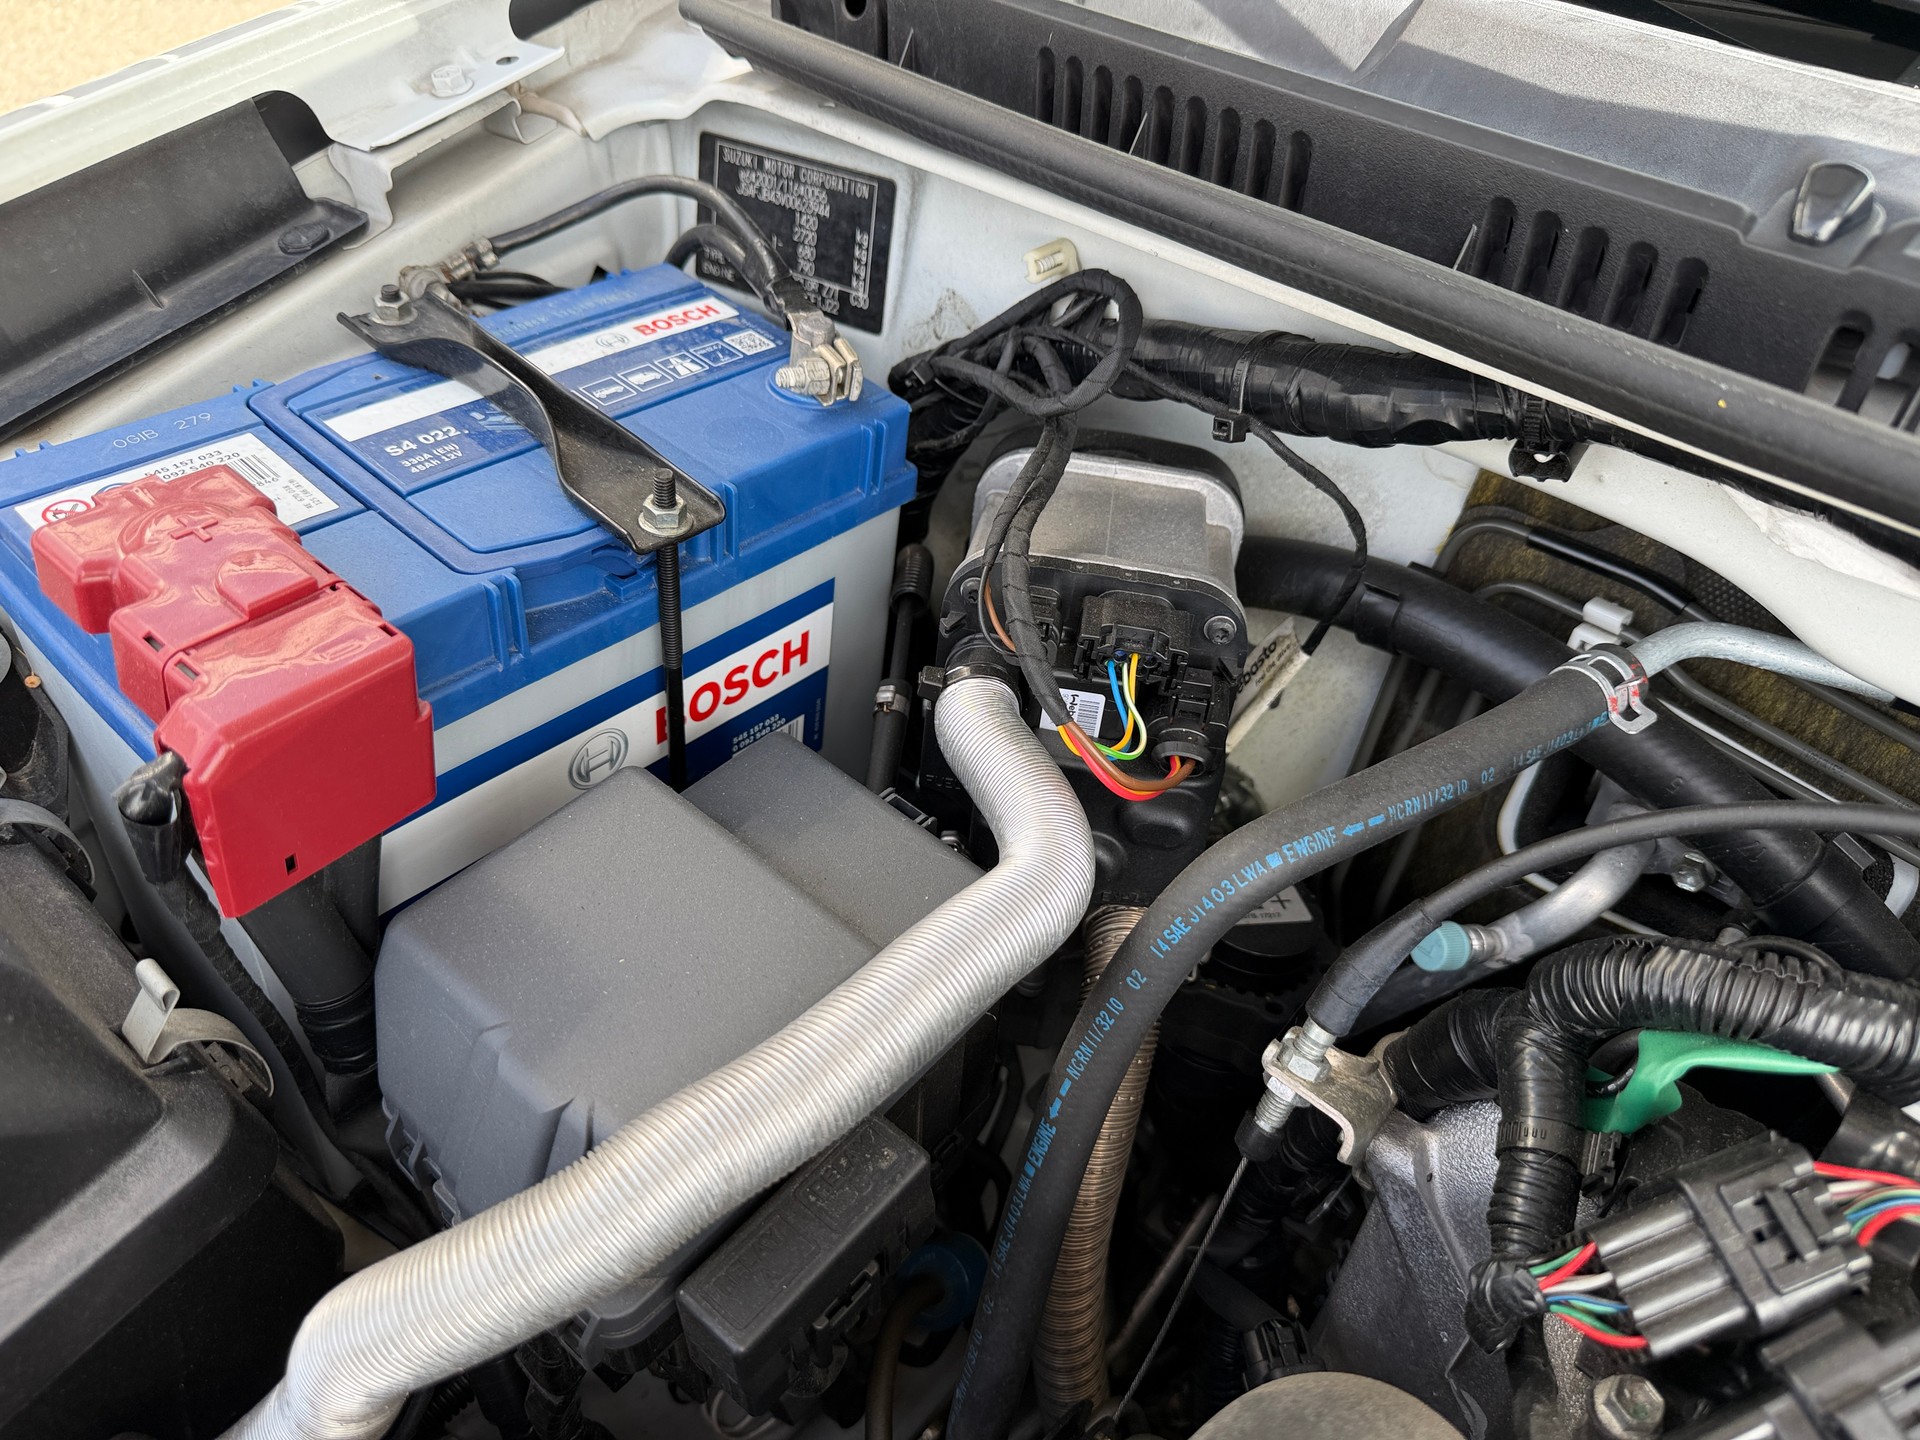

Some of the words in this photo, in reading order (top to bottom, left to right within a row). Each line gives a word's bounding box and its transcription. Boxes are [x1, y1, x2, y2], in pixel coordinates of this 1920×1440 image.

[722, 147, 758, 169] SUZUKI
[763, 157, 796, 179] MOTOR
[800, 167, 870, 200] CORPORATION
[702, 260, 736, 283] ENGINE
[632, 304, 721, 337] BOSCH
[174, 412, 211, 430] 279
[172, 458, 195, 470] 157
[197, 450, 222, 461] 033
[384, 439, 418, 458] S4
[401, 452, 434, 469] 330A
[433, 443, 460, 458] (EN)
[162, 468, 187, 481] 092
[216, 452, 241, 464] 220
[410, 459, 441, 475] 45Ah
[439, 451, 463, 464] 12V
[732, 744, 738, 752] 0
[739, 737, 754, 748] 092
[771, 717, 786, 730] 220
[749, 722, 764, 736] 157
[764, 713, 780, 727] 033
[1480, 767, 1496, 785] 02
[1281, 825, 1339, 864] ENGINE
[1125, 968, 1148, 991] 02
[1027, 1117, 1057, 1169] ENGINE
